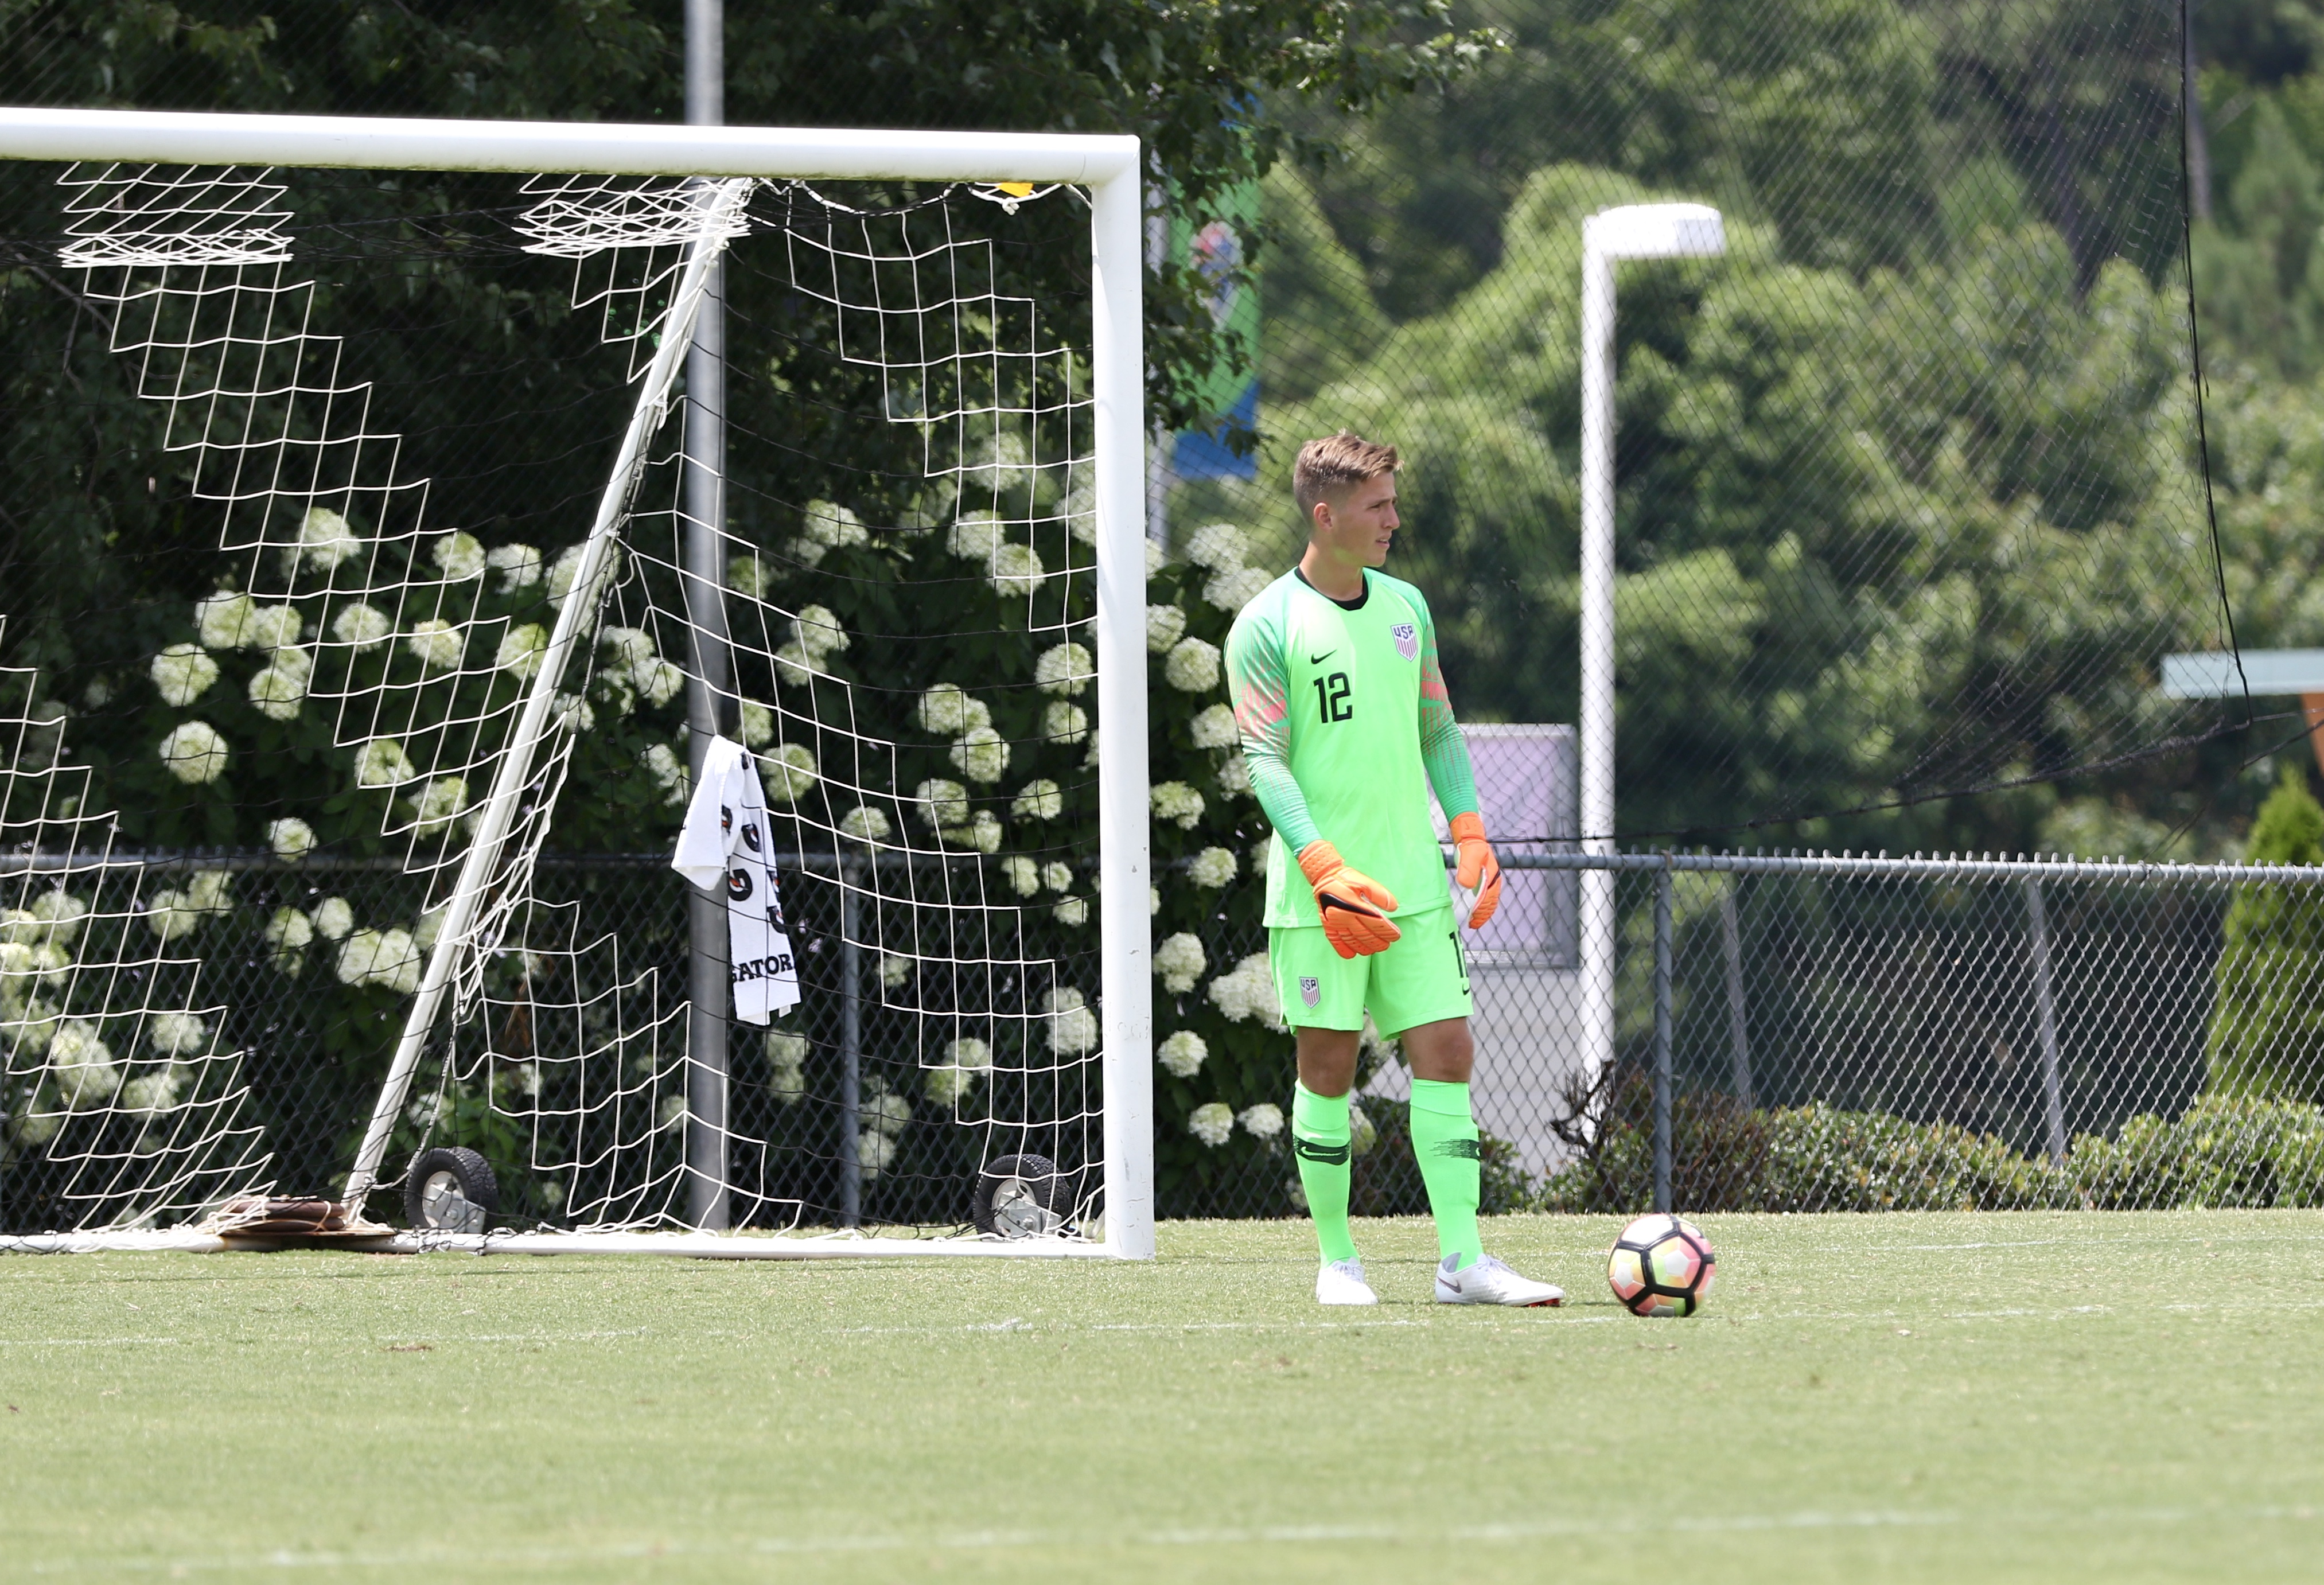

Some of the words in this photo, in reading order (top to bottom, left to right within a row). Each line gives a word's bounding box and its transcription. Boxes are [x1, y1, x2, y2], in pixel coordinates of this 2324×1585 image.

[1393, 625, 1414, 640] USA
[1314, 672, 1352, 723] 12
[1449, 930, 1469, 978] 1
[1301, 979, 1316, 991] USA
